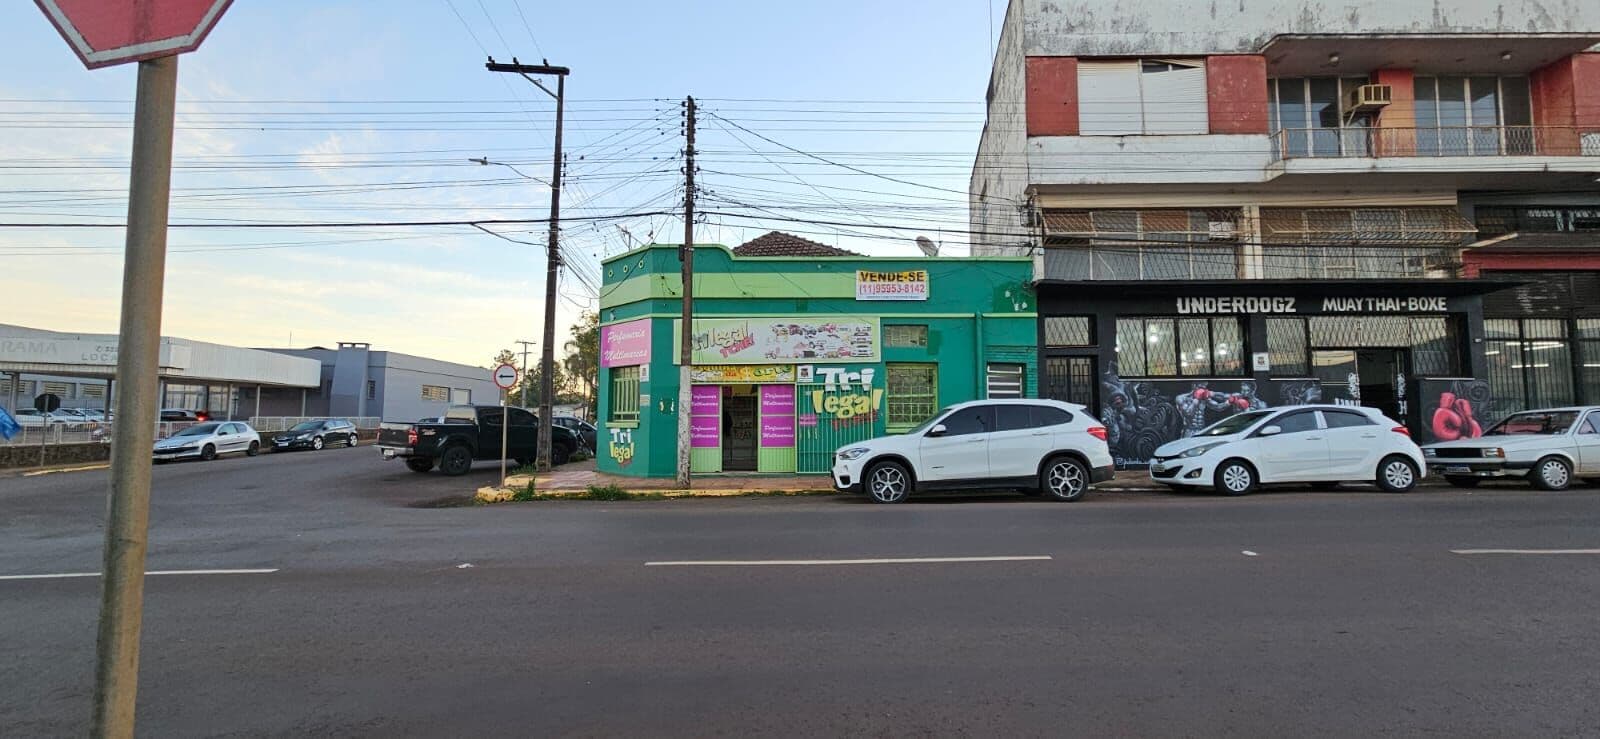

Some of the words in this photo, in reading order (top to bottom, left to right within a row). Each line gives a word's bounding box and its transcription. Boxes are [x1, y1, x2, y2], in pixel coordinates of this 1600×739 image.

[860, 271, 925, 282] VENDE-SE
[1176, 297, 1297, 313] UNDERDOGZ
[1322, 297, 1363, 311] MUAY
[1407, 297, 1448, 311] BOXE
[816, 368, 874, 391] Tri
[812, 389, 884, 418] legal
[610, 428, 631, 443] Tri
[610, 441, 635, 463] legal
